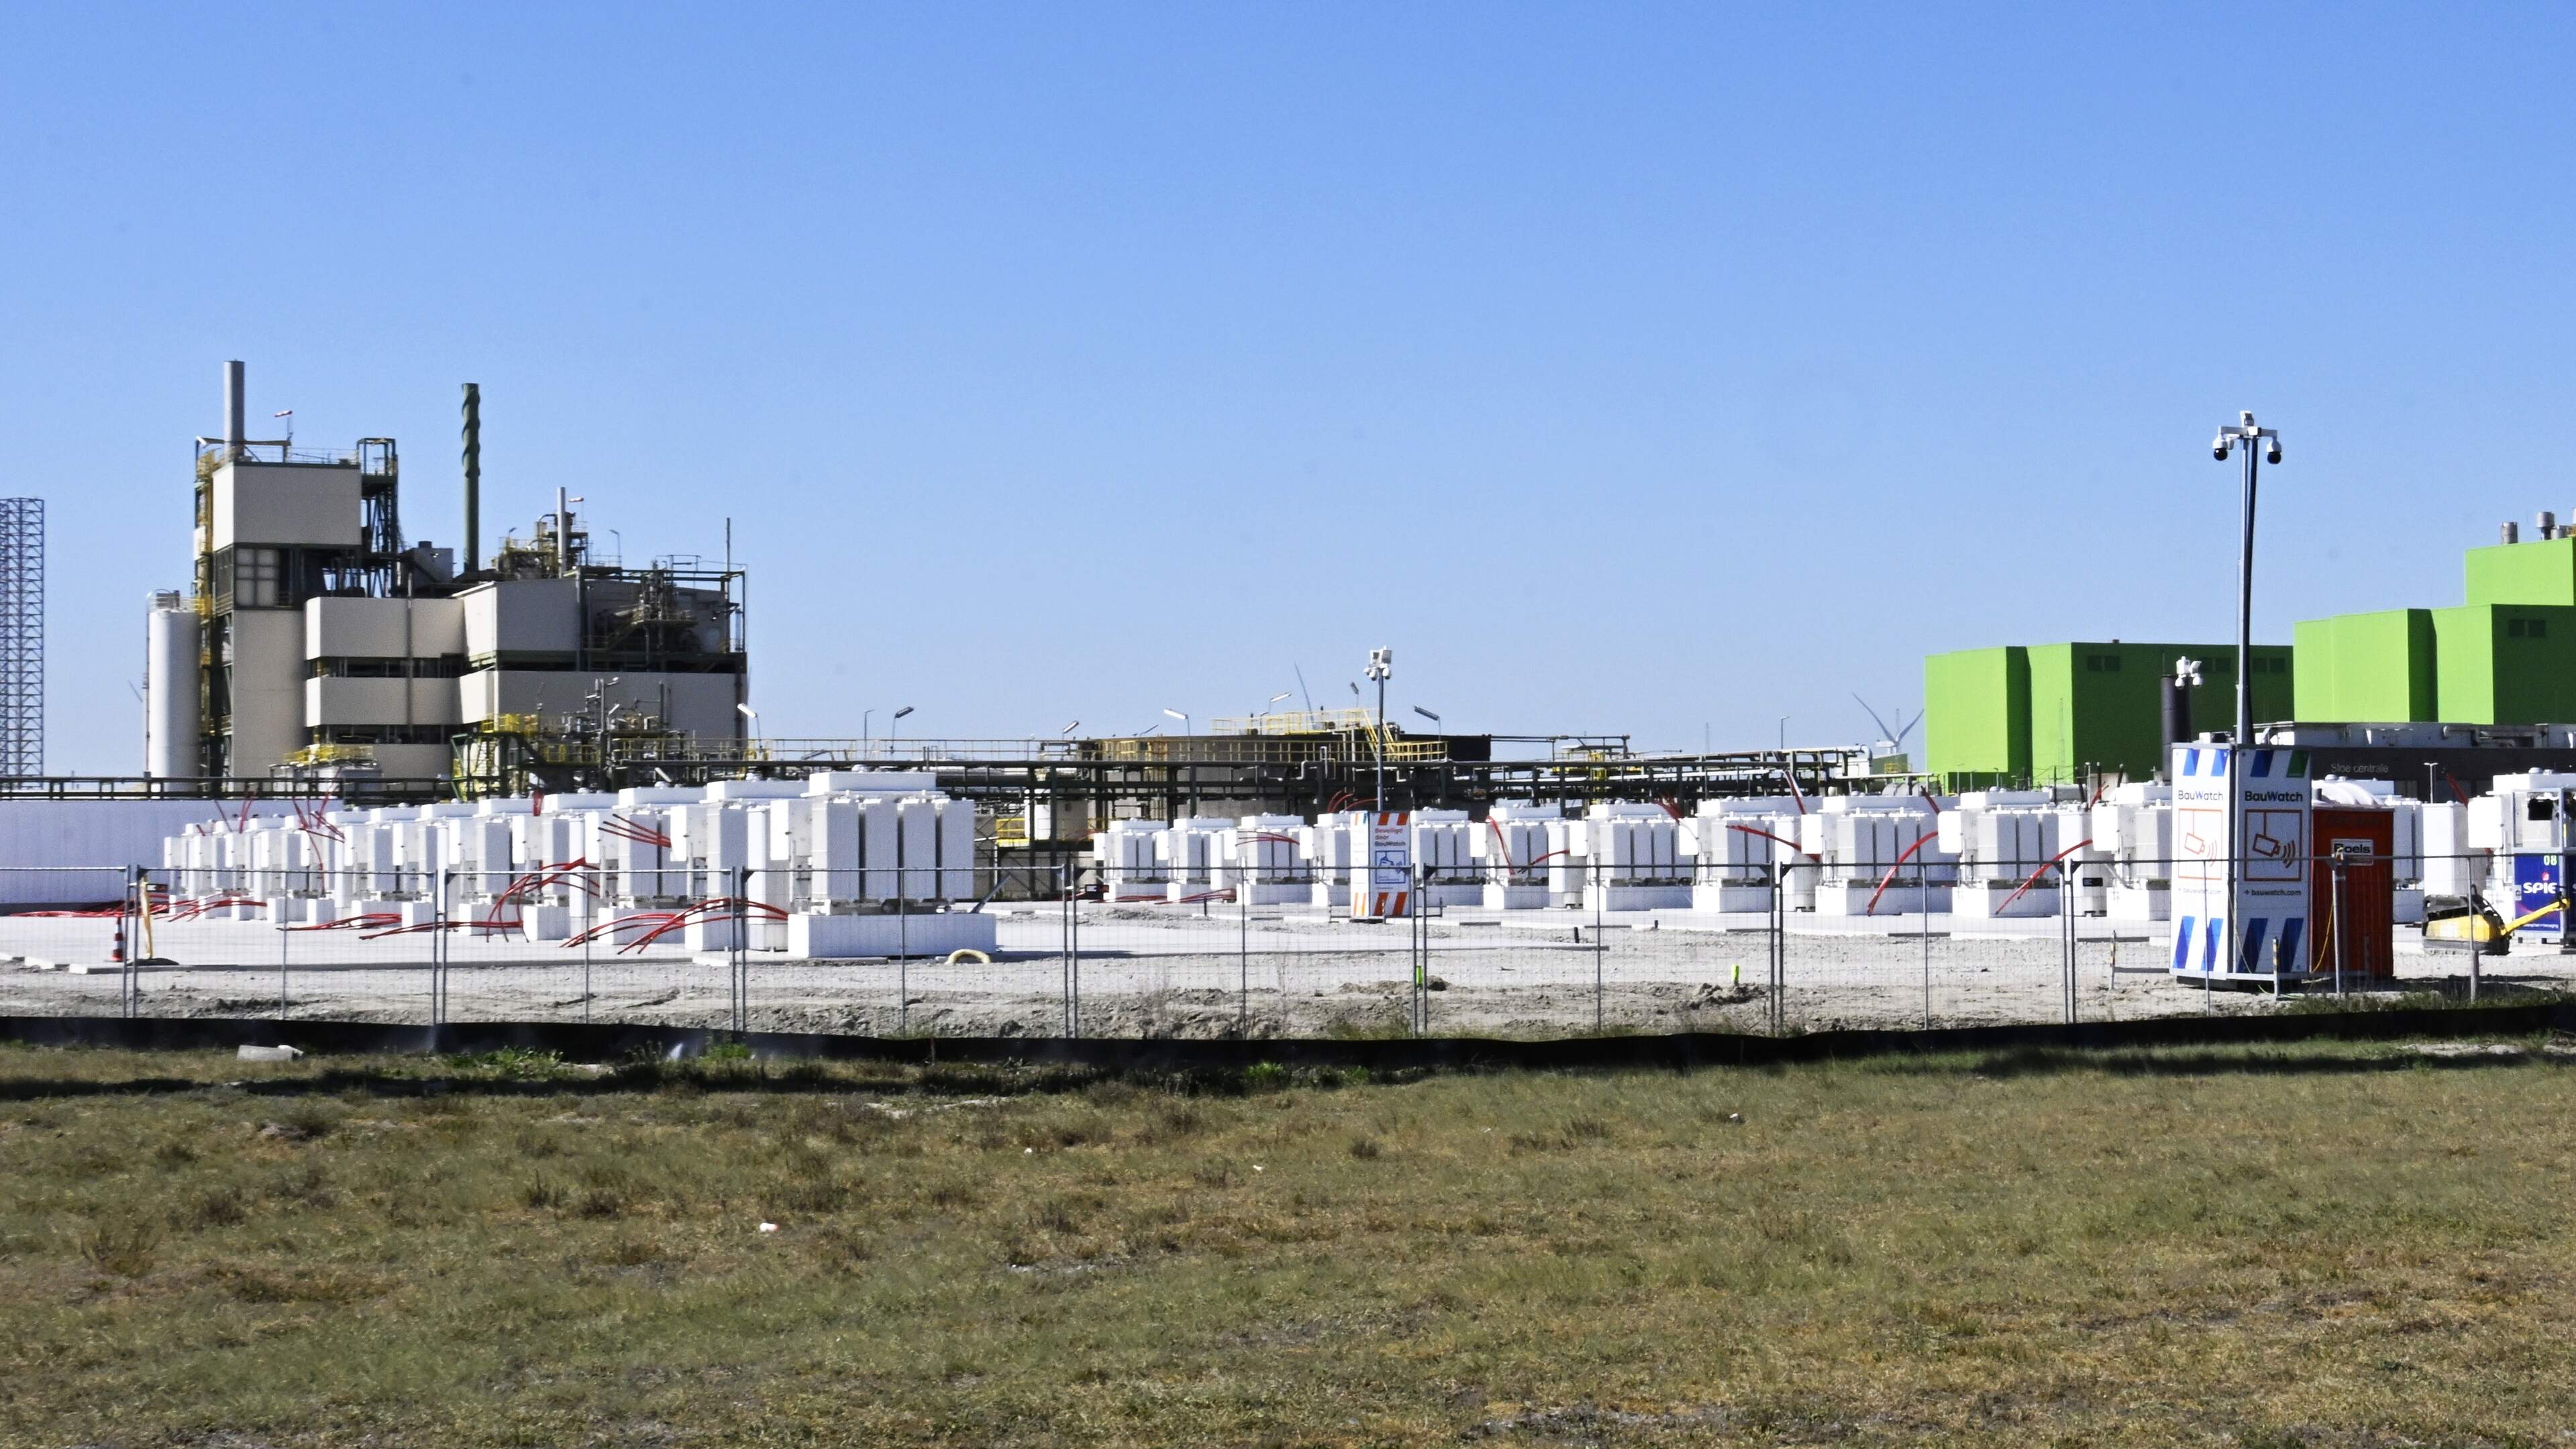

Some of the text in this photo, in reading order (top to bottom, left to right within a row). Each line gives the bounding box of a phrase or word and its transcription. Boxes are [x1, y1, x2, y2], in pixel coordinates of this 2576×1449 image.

[2330, 763, 2389, 773] Sloe centrale
[2178, 790, 2224, 801] BauWatch
[2245, 790, 2303, 802] BauWatch
[2543, 855, 2557, 866] 08
[2523, 881, 2557, 894] SPIE
